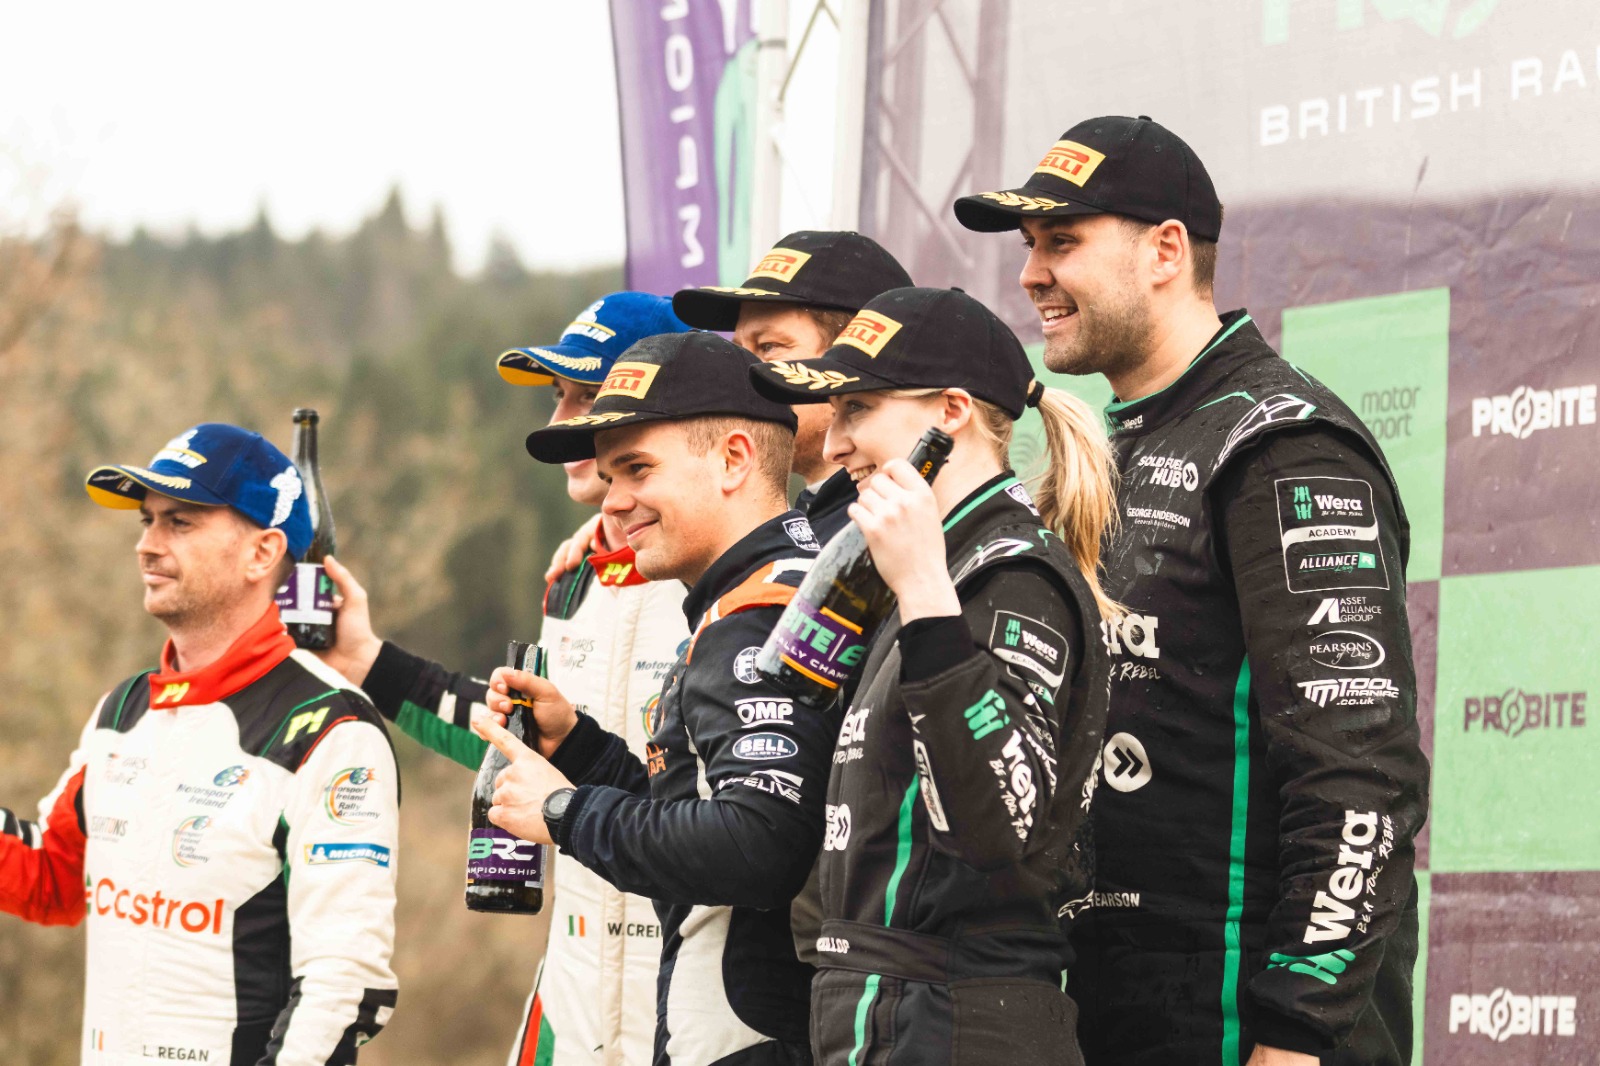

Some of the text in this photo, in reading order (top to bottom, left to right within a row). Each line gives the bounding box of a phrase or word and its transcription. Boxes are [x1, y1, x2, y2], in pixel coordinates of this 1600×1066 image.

[1260, 67, 1481, 147] BRITISH
[1361, 386, 1421, 415] motor
[1472, 386, 1597, 438] PROBITE
[1366, 413, 1413, 440] port
[1138, 456, 1183, 471] SOLID FUEL
[1149, 468, 1182, 488] HUB
[1314, 495, 1363, 511] Wera
[1126, 507, 1191, 528] GEORGE ANDERSON
[1308, 528, 1357, 538] ACADEMY
[1300, 555, 1358, 570] ALLIANCE
[1340, 597, 1366, 605] ASSET
[1340, 606, 1382, 614] ALLIANCE
[1341, 614, 1373, 623] GROUP
[1021, 630, 1059, 661] Wera
[1309, 642, 1372, 655] PEARSONS
[1120, 661, 1161, 682] REBEL
[1336, 697, 1375, 706] .co.uk
[1346, 689, 1399, 698] MANIAC
[737, 701, 793, 724] OMP
[1463, 687, 1587, 738] PROBITE
[739, 739, 789, 754] BELL
[338, 802, 360, 810] Rally
[328, 847, 389, 863] MICHELIN
[468, 837, 537, 861] BRC
[1365, 865, 1383, 896] TOOL
[1378, 814, 1394, 860] REBEL
[1303, 810, 1378, 944] Wera
[1449, 987, 1577, 1043] PROBITE
[158, 1046, 210, 1062] REGAN
